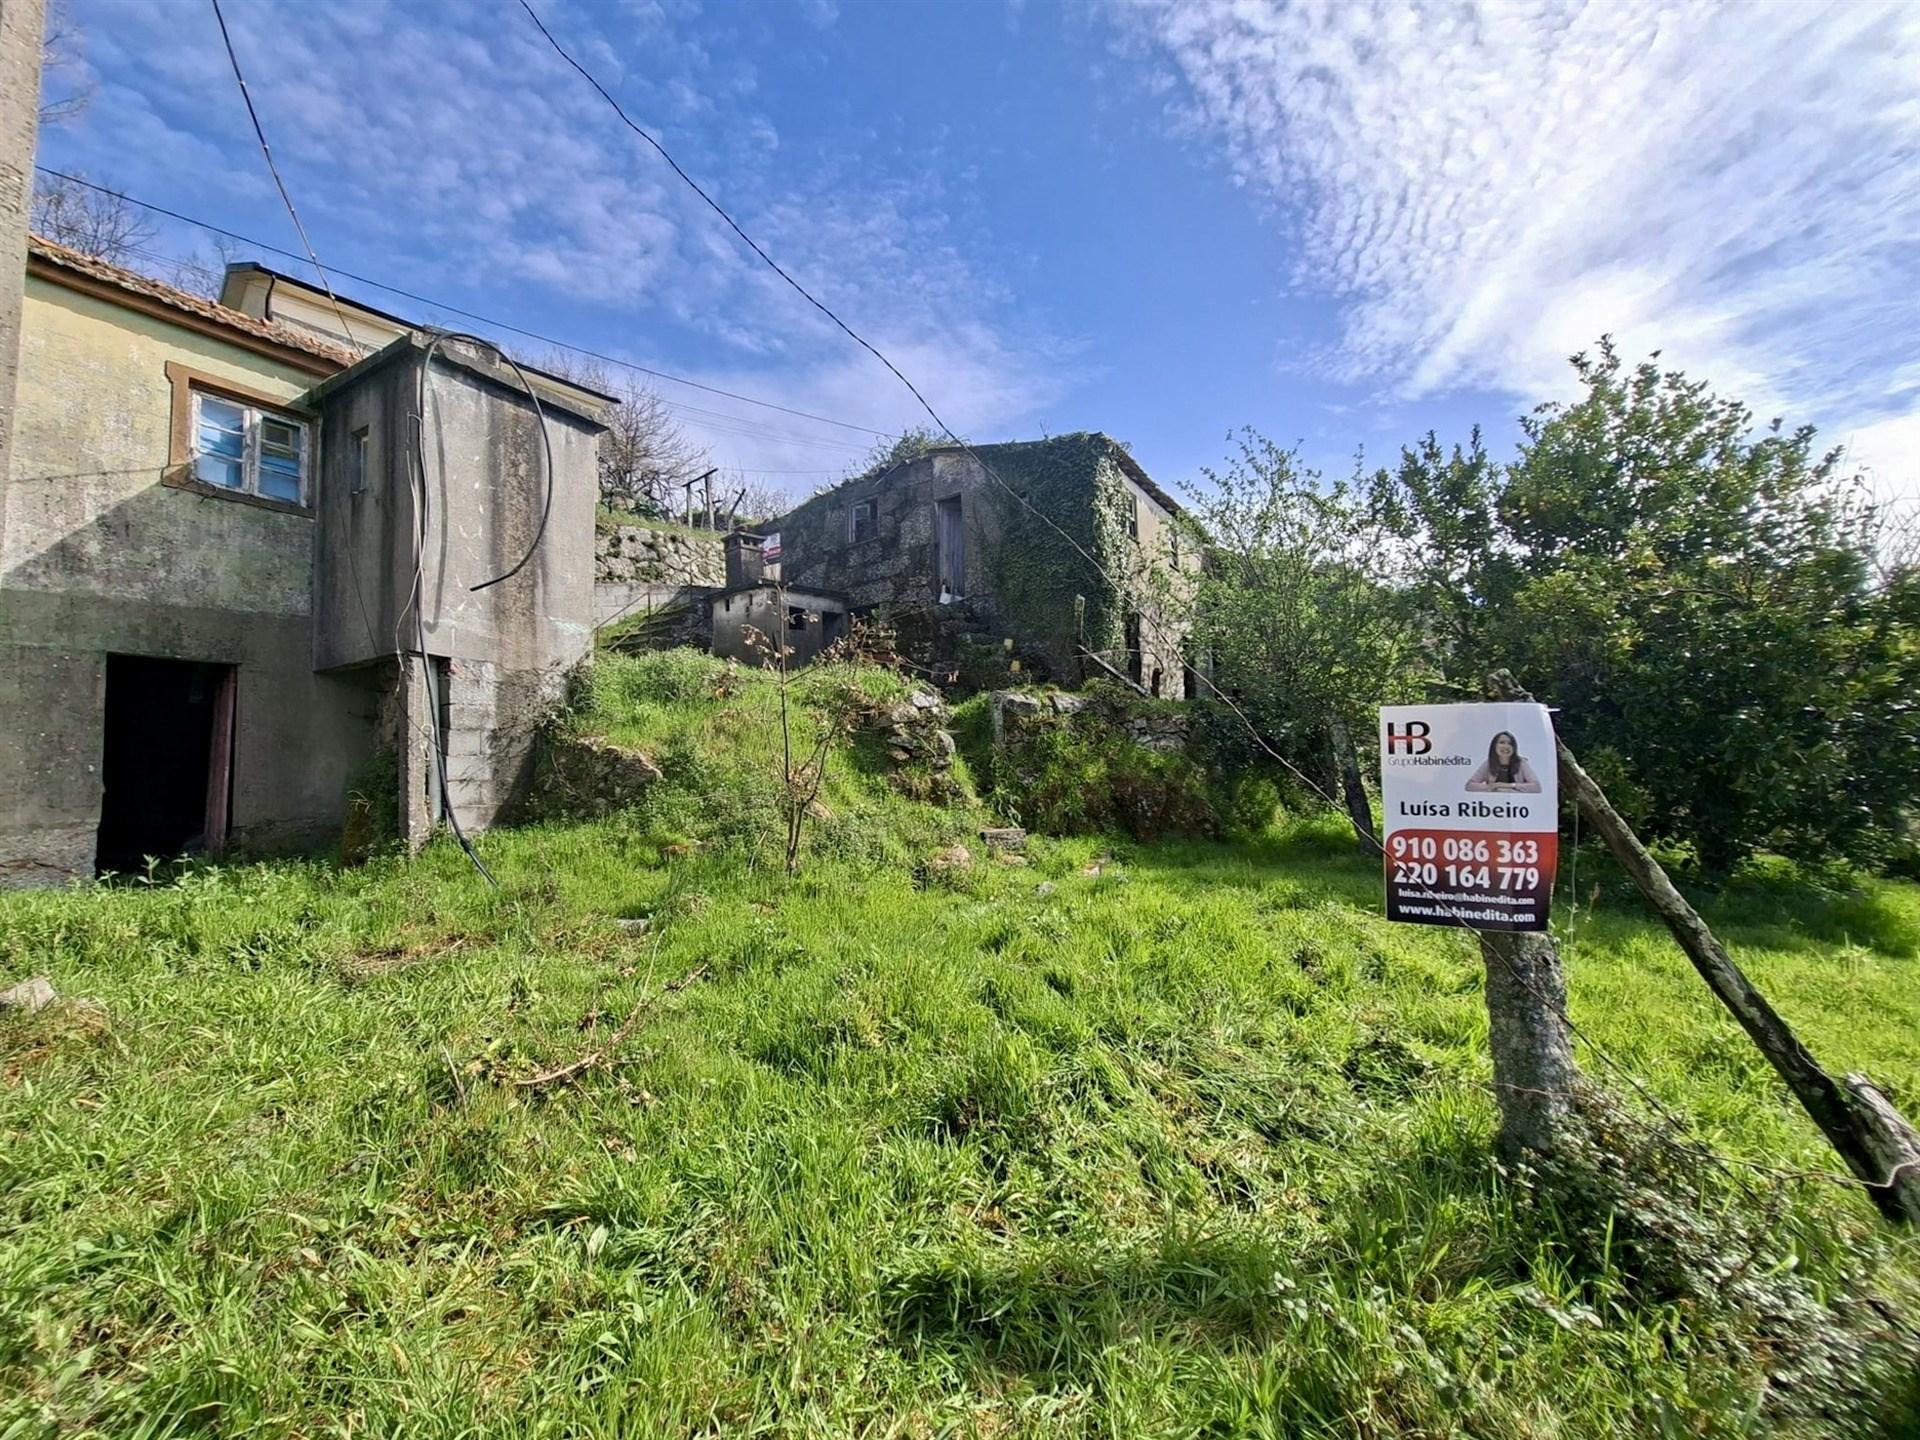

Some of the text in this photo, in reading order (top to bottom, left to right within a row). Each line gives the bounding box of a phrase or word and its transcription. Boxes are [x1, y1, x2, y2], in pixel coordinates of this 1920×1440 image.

[1387, 721, 1432, 755] HB
[1400, 800, 1529, 818] Luísa Ribeiro
[1392, 837, 1538, 864] 910 086 363
[1393, 862, 1539, 890] 220 164 779
[1398, 904, 1535, 922] www.habinedita.com
